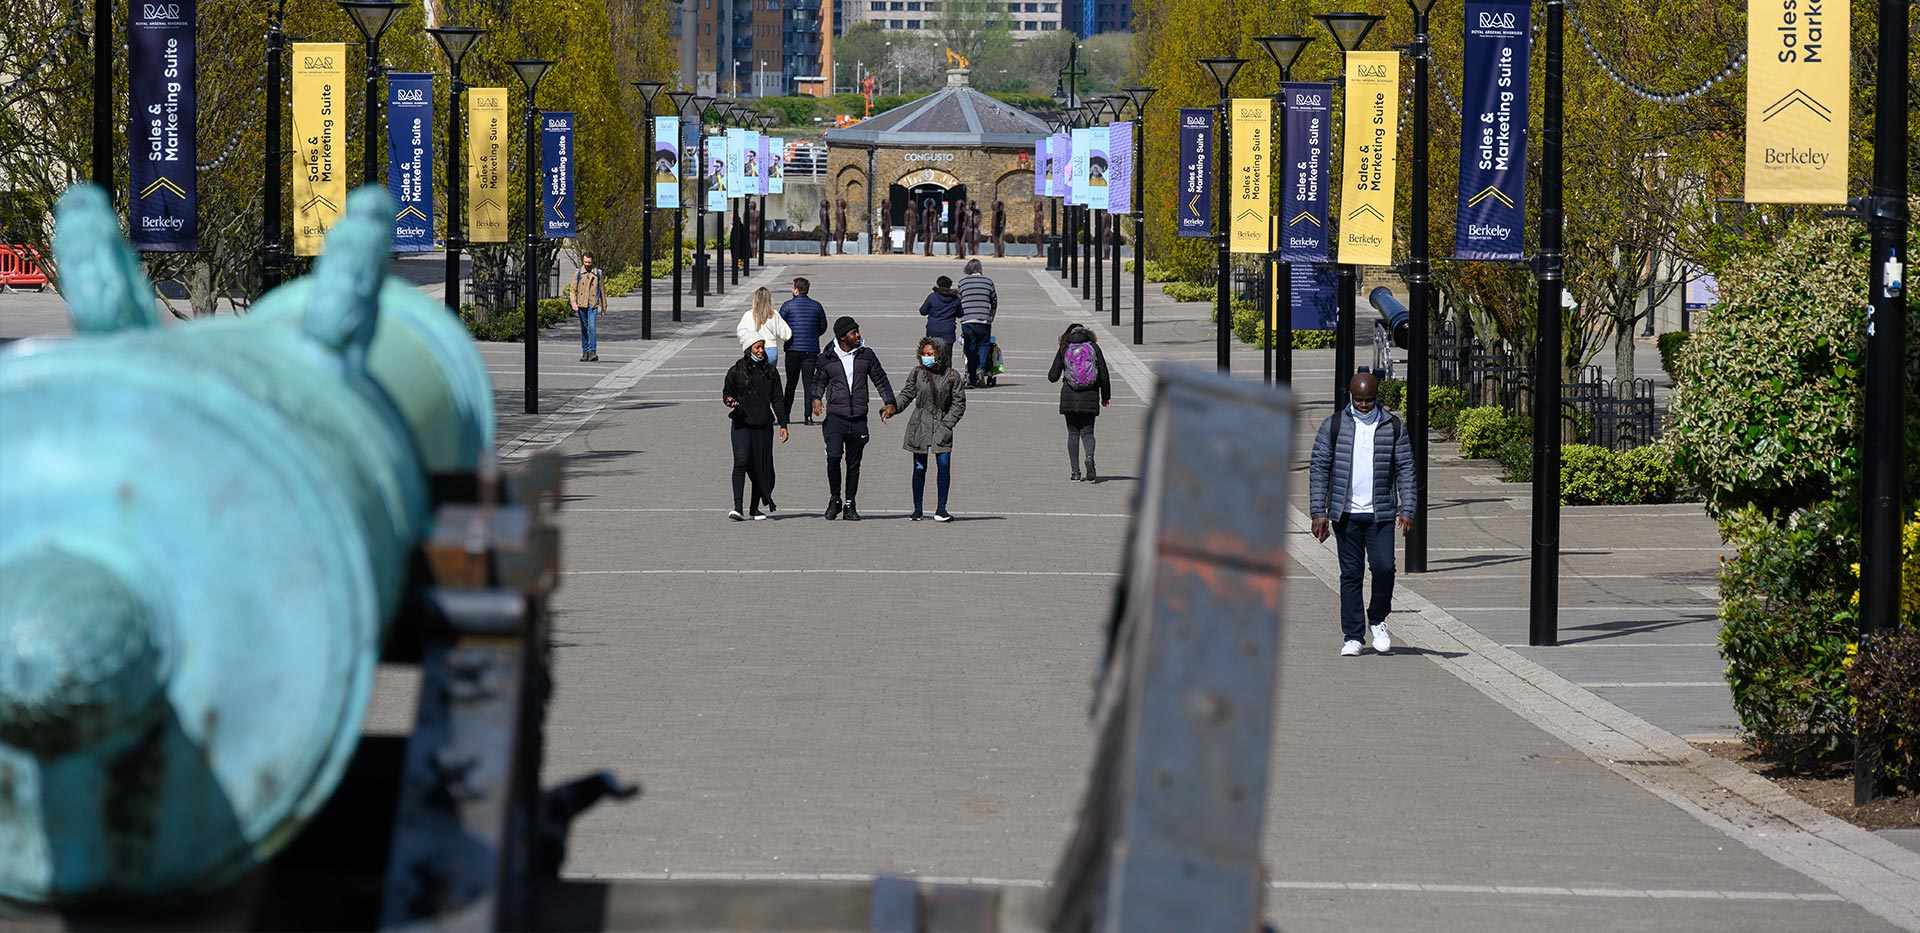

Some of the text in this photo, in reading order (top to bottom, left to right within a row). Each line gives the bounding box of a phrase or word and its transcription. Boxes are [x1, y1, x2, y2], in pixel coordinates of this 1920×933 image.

[144, 4, 180, 20] RAR
[1480, 12, 1515, 28] RAR
[1778, 0, 1797, 63] Sales
[304, 56, 334, 70] RAR
[165, 38, 181, 161] Marketing Suite
[398, 89, 422, 101] RAR
[1495, 48, 1513, 170] Marketing Suite
[148, 103, 162, 161] Sales &
[323, 85, 333, 182] Marketing Suite
[1371, 93, 1386, 191] Marketing Suite
[1480, 112, 1493, 169] Sales &
[309, 147, 318, 182] Sales
[413, 119, 423, 201] Marketing Suite
[490, 144, 498, 189] Marketing
[904, 153, 954, 161] CONGUSTO
[1308, 118, 1320, 201] Marketing Suite
[1358, 145, 1369, 190] Sales &
[1765, 147, 1829, 170] Berkeley
[1196, 154, 1205, 192] Marketing
[1252, 154, 1262, 199] Marketing
[1297, 173, 1306, 200] Sales
[142, 216, 184, 232] Berkeley
[396, 227, 425, 237] Berkeley
[1184, 218, 1204, 227] Berkeley
[1238, 231, 1262, 240] Berkeley
[1468, 224, 1511, 240] Berkeley
[1290, 237, 1319, 248] Berkeley
[1348, 234, 1382, 246] Berkeley
